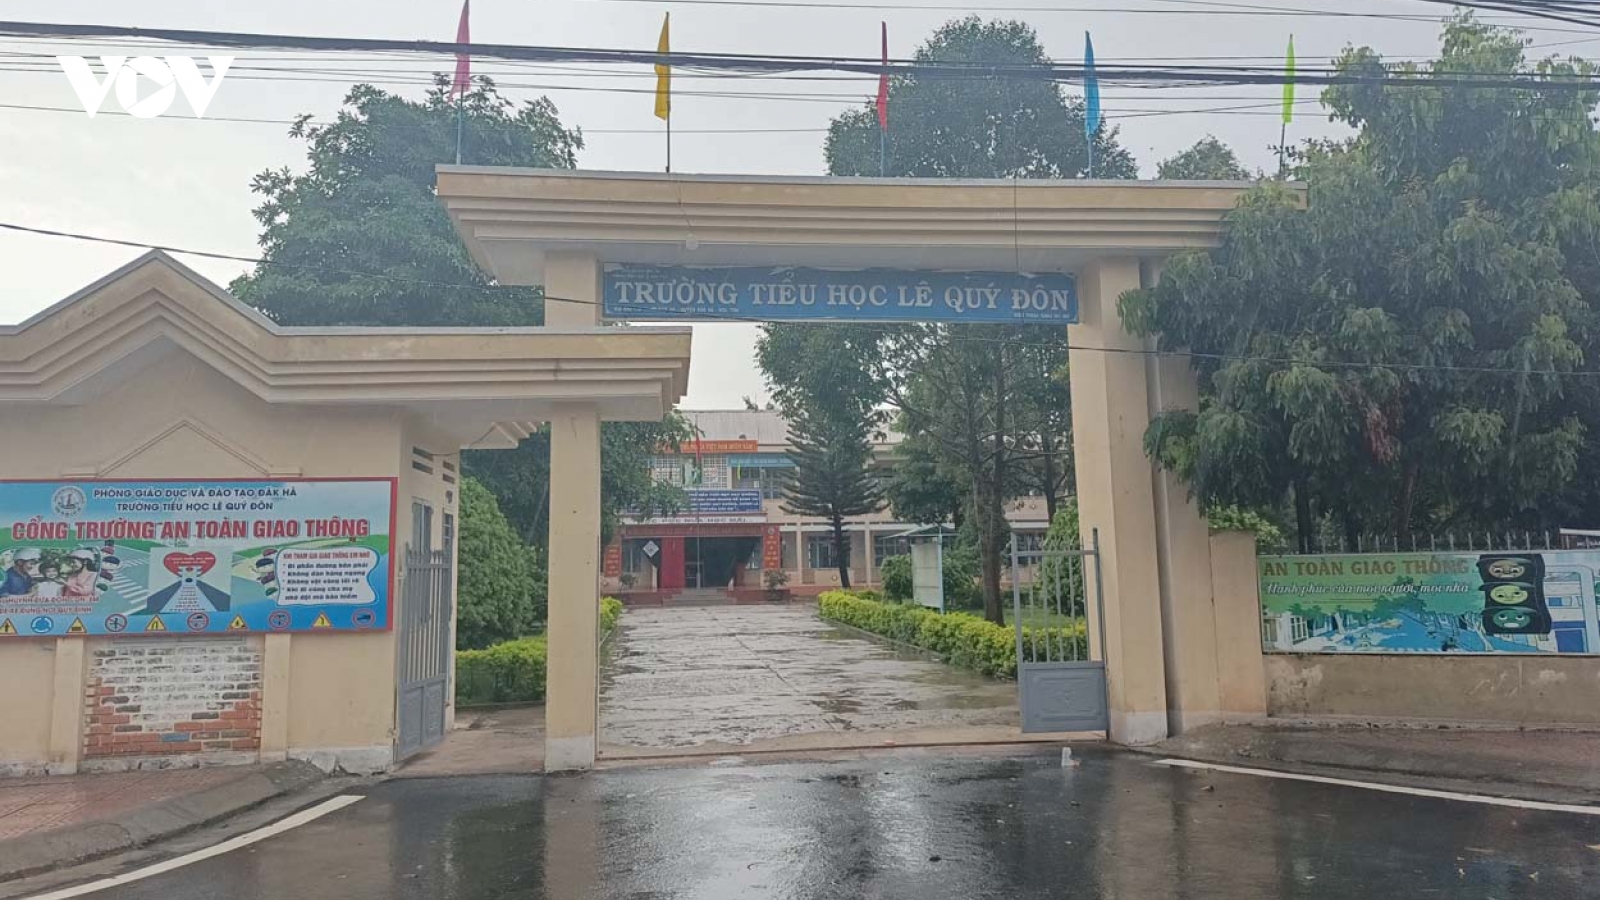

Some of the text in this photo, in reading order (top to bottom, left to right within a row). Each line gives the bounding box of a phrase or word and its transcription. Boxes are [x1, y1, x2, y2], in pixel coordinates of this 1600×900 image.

[614, 271, 1069, 312] TRƯỜNG TIỂU HỌC LÊ QUÝ ĐÔN
[94, 487, 132, 497] PHÒNG
[135, 486, 162, 497] GIÁO
[165, 488, 187, 498] DỤC
[190, 487, 206, 497] VÀ
[208, 487, 231, 497] ĐÀO
[282, 487, 297, 496] HÀ
[117, 500, 273, 513] TRƯỜNG TIỂU HỌC LÊ QUÝ ĐÔN
[12, 515, 370, 540] CỔNG TRƯỜNG AN TOÀN GIAO THÔNG
[1263, 555, 1470, 576] AN TOÀN GIAO THÔNG
